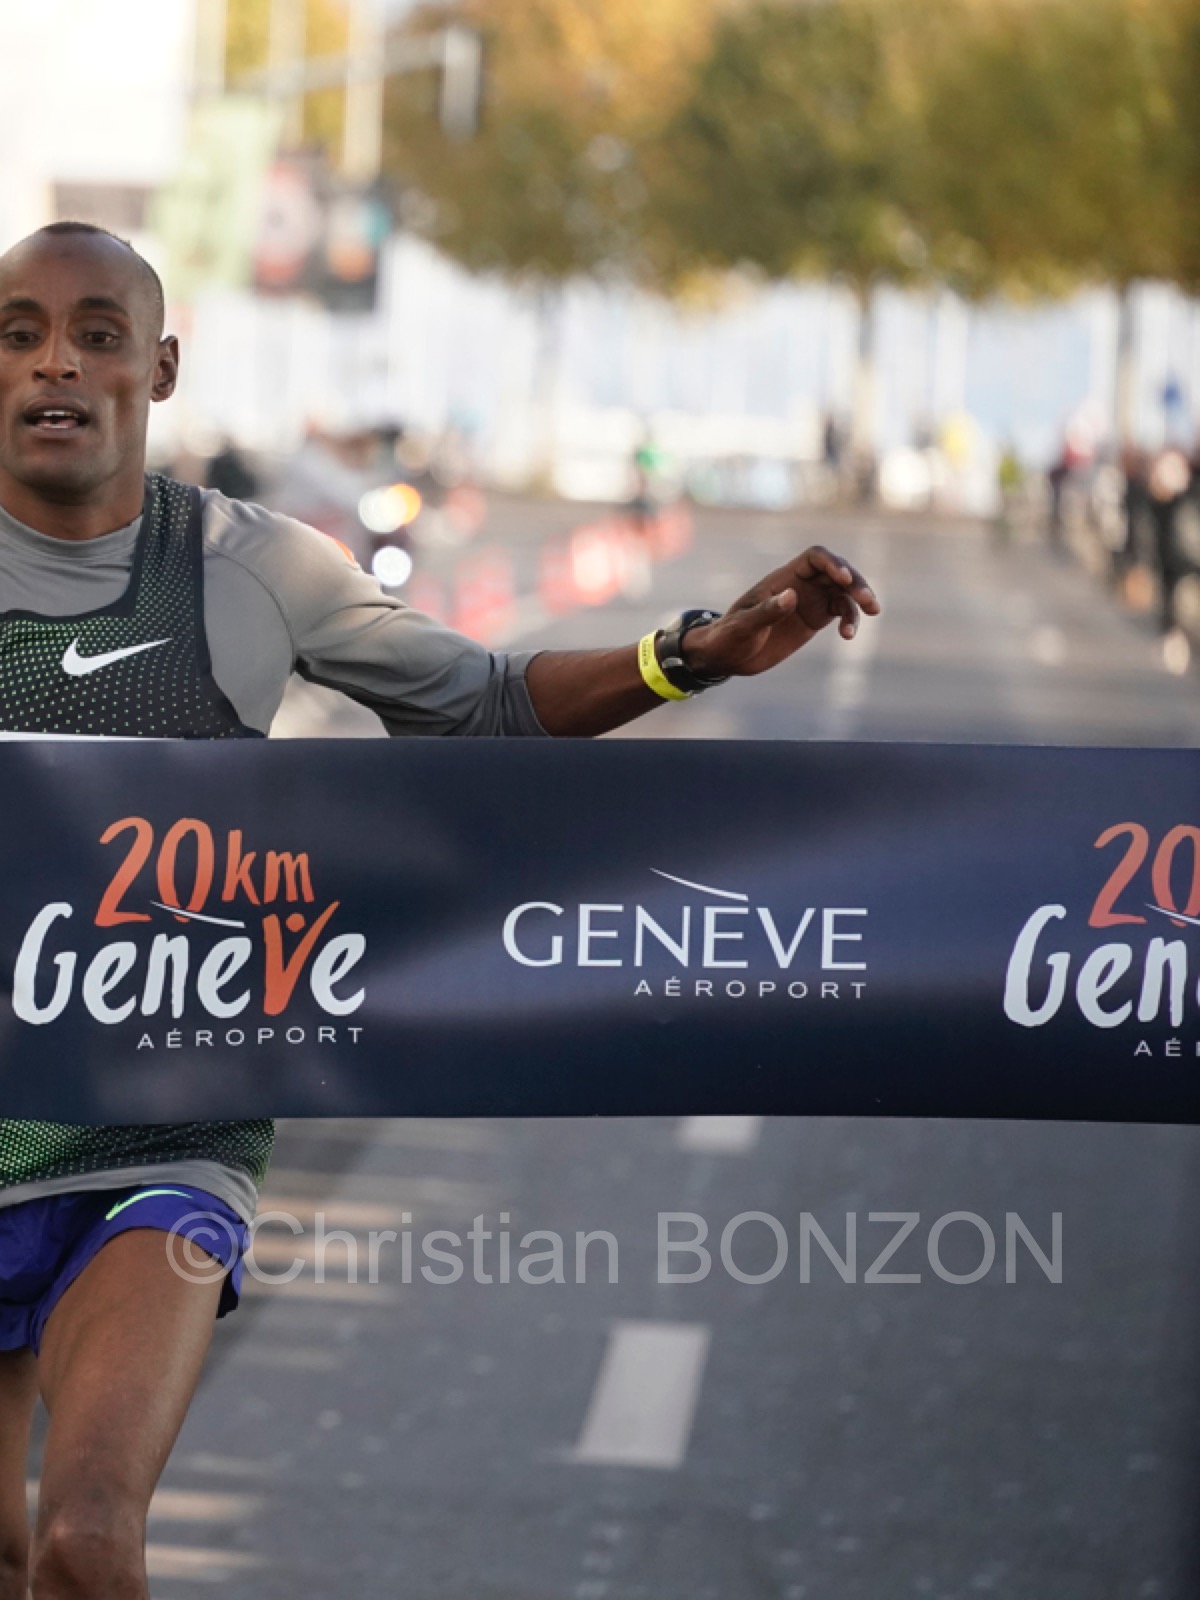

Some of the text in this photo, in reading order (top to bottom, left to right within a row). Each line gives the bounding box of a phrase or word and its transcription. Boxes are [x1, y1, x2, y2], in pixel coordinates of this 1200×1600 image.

[502, 867, 869, 972] GENÈVE
[634, 976, 867, 1001] AÉROPORT
[1003, 903, 1200, 1029] Gen
[136, 1025, 366, 1051] AÉROPORT
